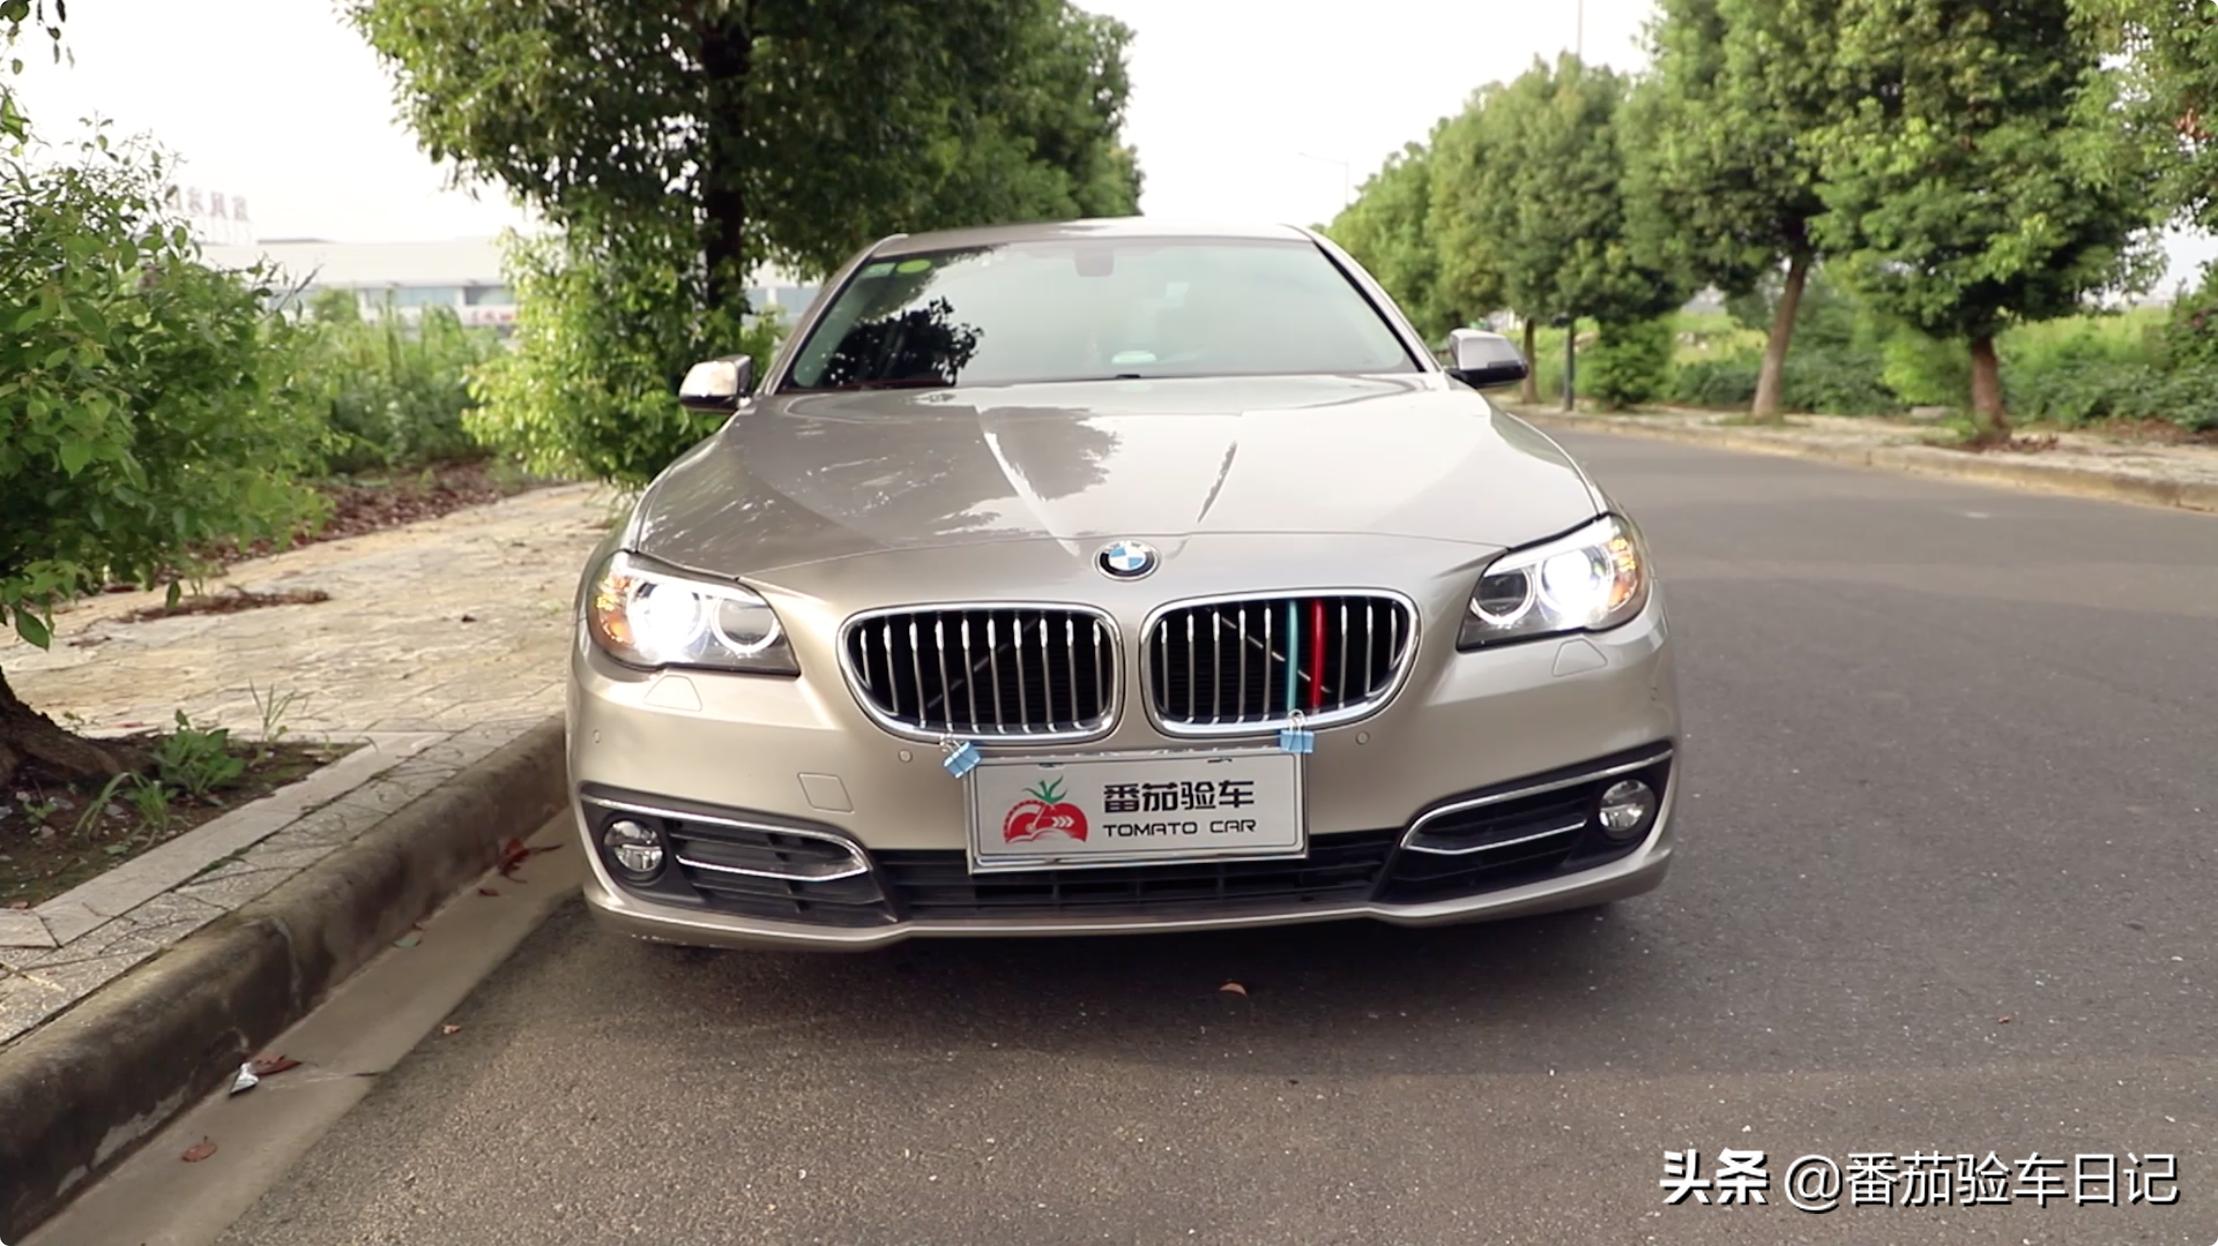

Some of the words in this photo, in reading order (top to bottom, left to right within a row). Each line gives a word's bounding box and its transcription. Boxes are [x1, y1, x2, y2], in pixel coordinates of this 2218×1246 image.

[1104, 780, 1254, 813] 番茄验车
[1103, 821, 1198, 837] TOMATO
[1210, 819, 1256, 833] CAR
